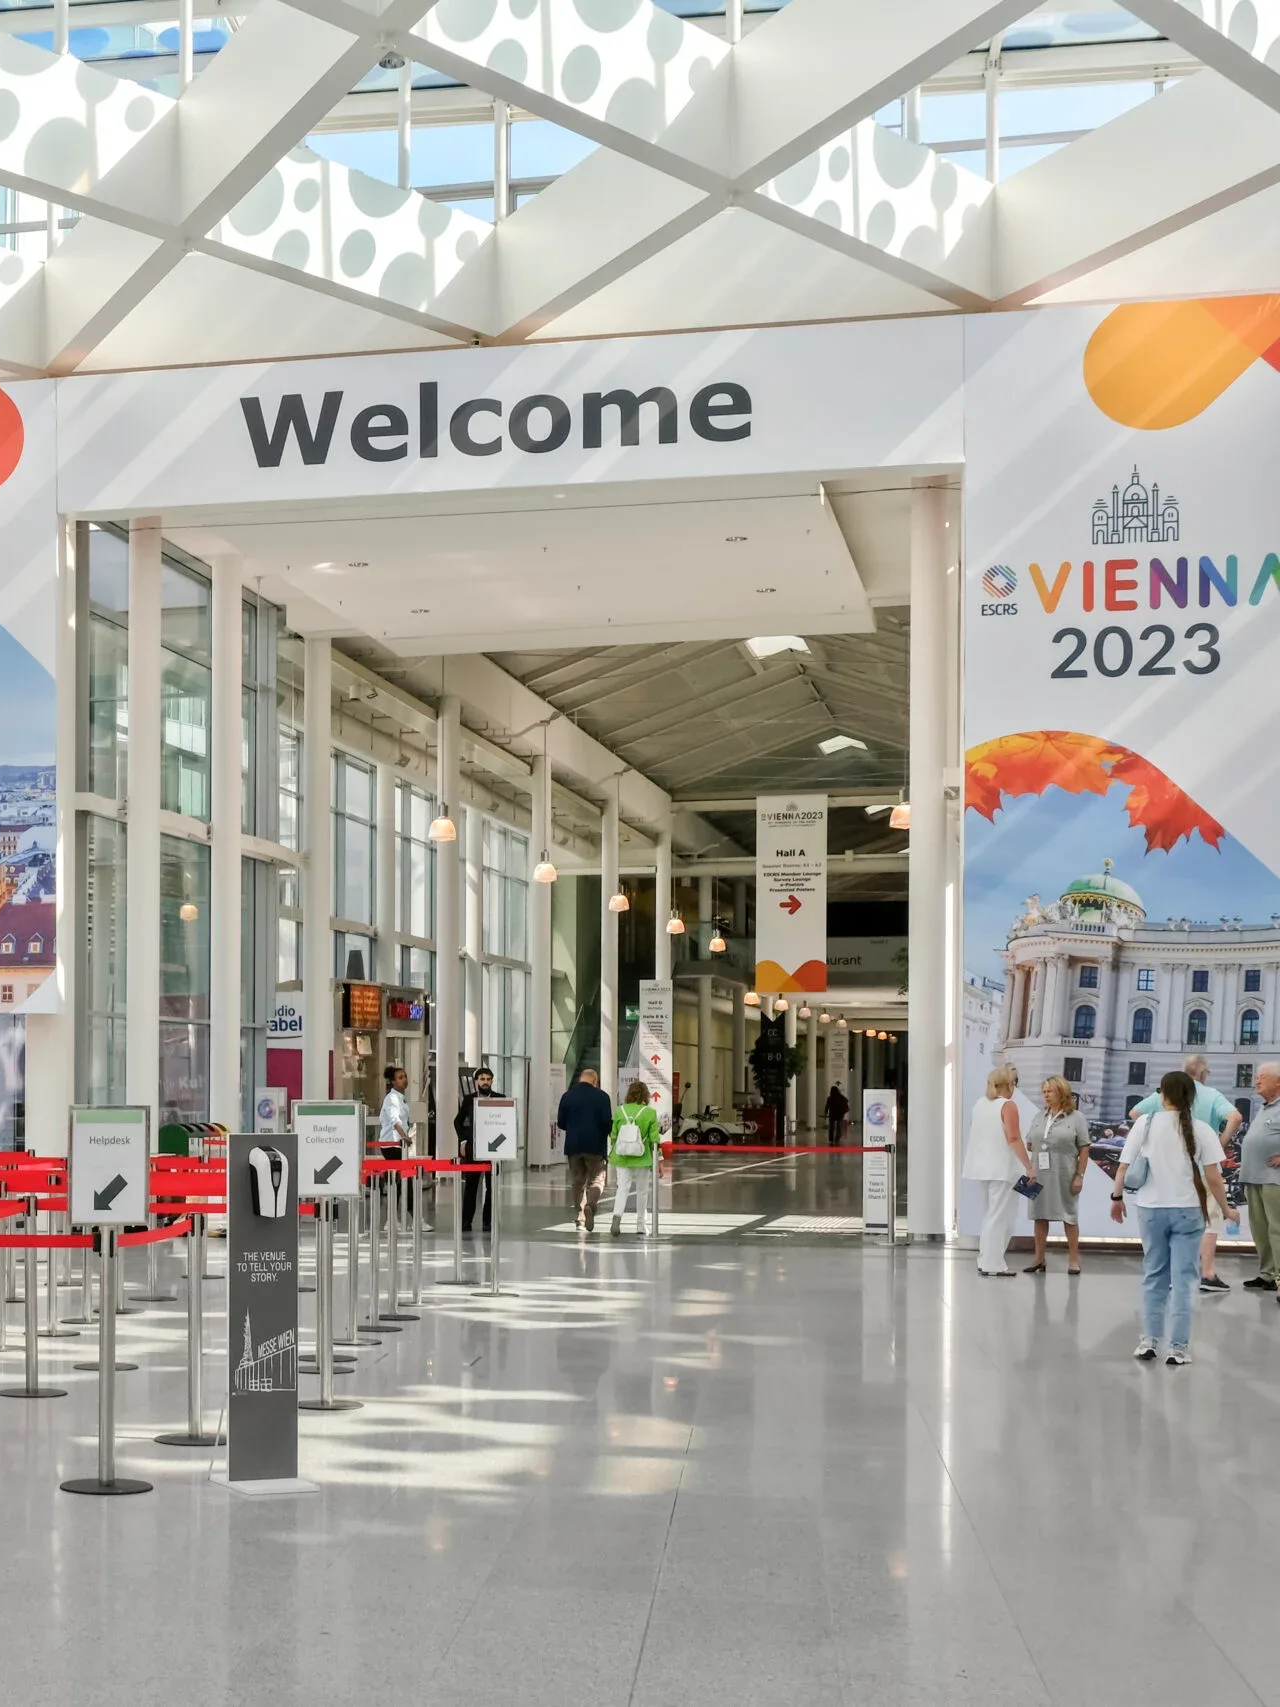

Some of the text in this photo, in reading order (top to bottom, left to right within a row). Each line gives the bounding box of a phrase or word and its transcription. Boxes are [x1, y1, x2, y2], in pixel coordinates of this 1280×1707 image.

[239, 380, 753, 468] Welcome
[1028, 552, 1280, 614] VIENNA
[981, 603, 1018, 616] ESCRS
[1050, 622, 1221, 679] 2023
[776, 849, 806, 857] Hall A
[274, 1005, 296, 1016] dio
[266, 1015, 303, 1032] abel
[312, 1124, 337, 1132] Badge
[89, 1135, 131, 1146] Helpdesk
[305, 1136, 345, 1144] Collection
[243, 1251, 286, 1261] THE VENUE
[237, 1262, 292, 1272] TO TELL YOUR
[251, 1272, 279, 1282] STORY.
[257, 1327, 295, 1359] MESSE WIEN
